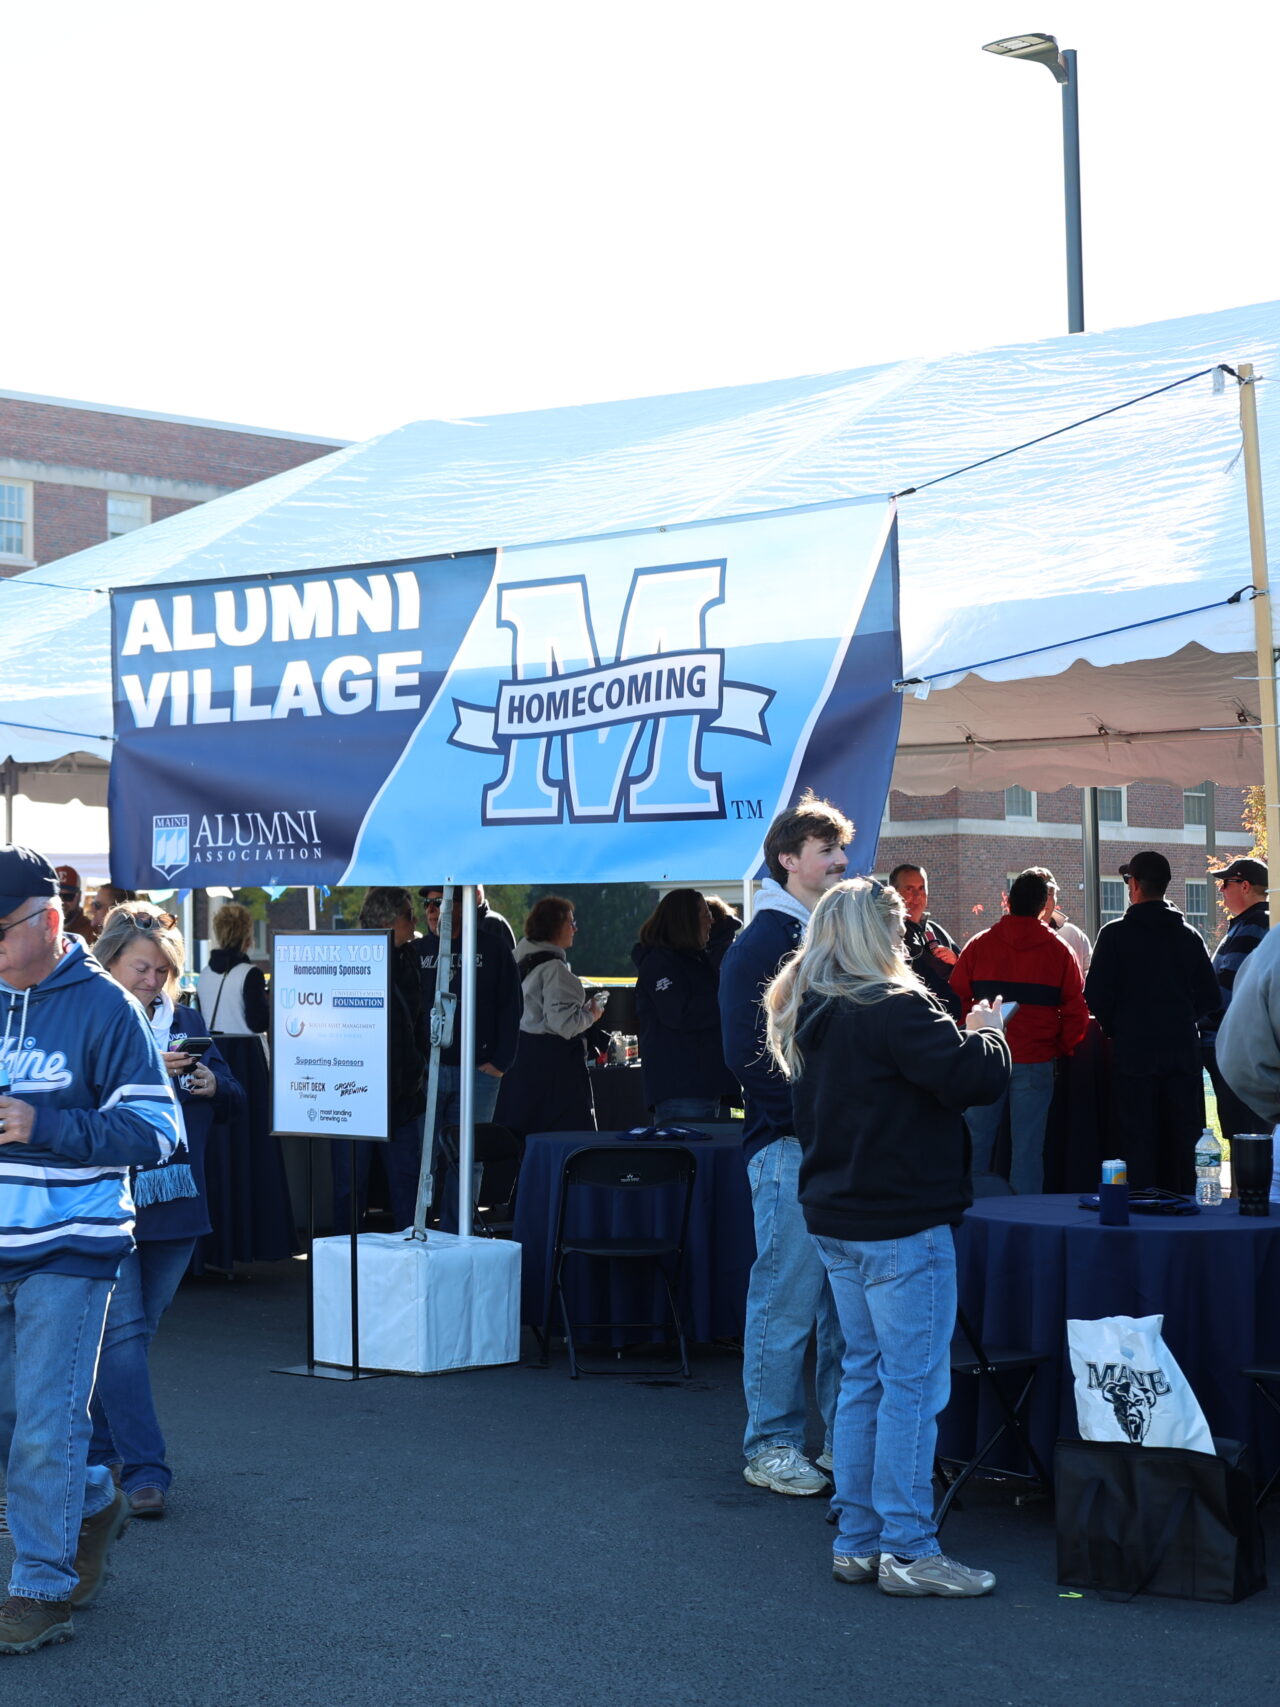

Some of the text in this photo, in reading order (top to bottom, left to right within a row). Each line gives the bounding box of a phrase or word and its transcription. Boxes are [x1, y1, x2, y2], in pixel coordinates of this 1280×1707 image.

[121, 571, 420, 656] ALUMNI
[121, 650, 423, 728] VILLAGE
[507, 664, 707, 725] HOMECOMING
[730, 799, 764, 820] TM
[155, 817, 187, 828] MAINE
[192, 810, 322, 848] ALUMNI
[194, 848, 322, 863] ASSOCIATION
[276, 945, 384, 962] THANK YOU
[294, 964, 371, 976] Homecoming Sponsors
[298, 992, 323, 1005] UCU
[295, 1056, 364, 1067] Supporting Sponsors
[290, 1081, 326, 1092] FLIGHT DECK
[340, 1086, 368, 1097] BREWING
[1086, 1361, 1173, 1396] MANE
